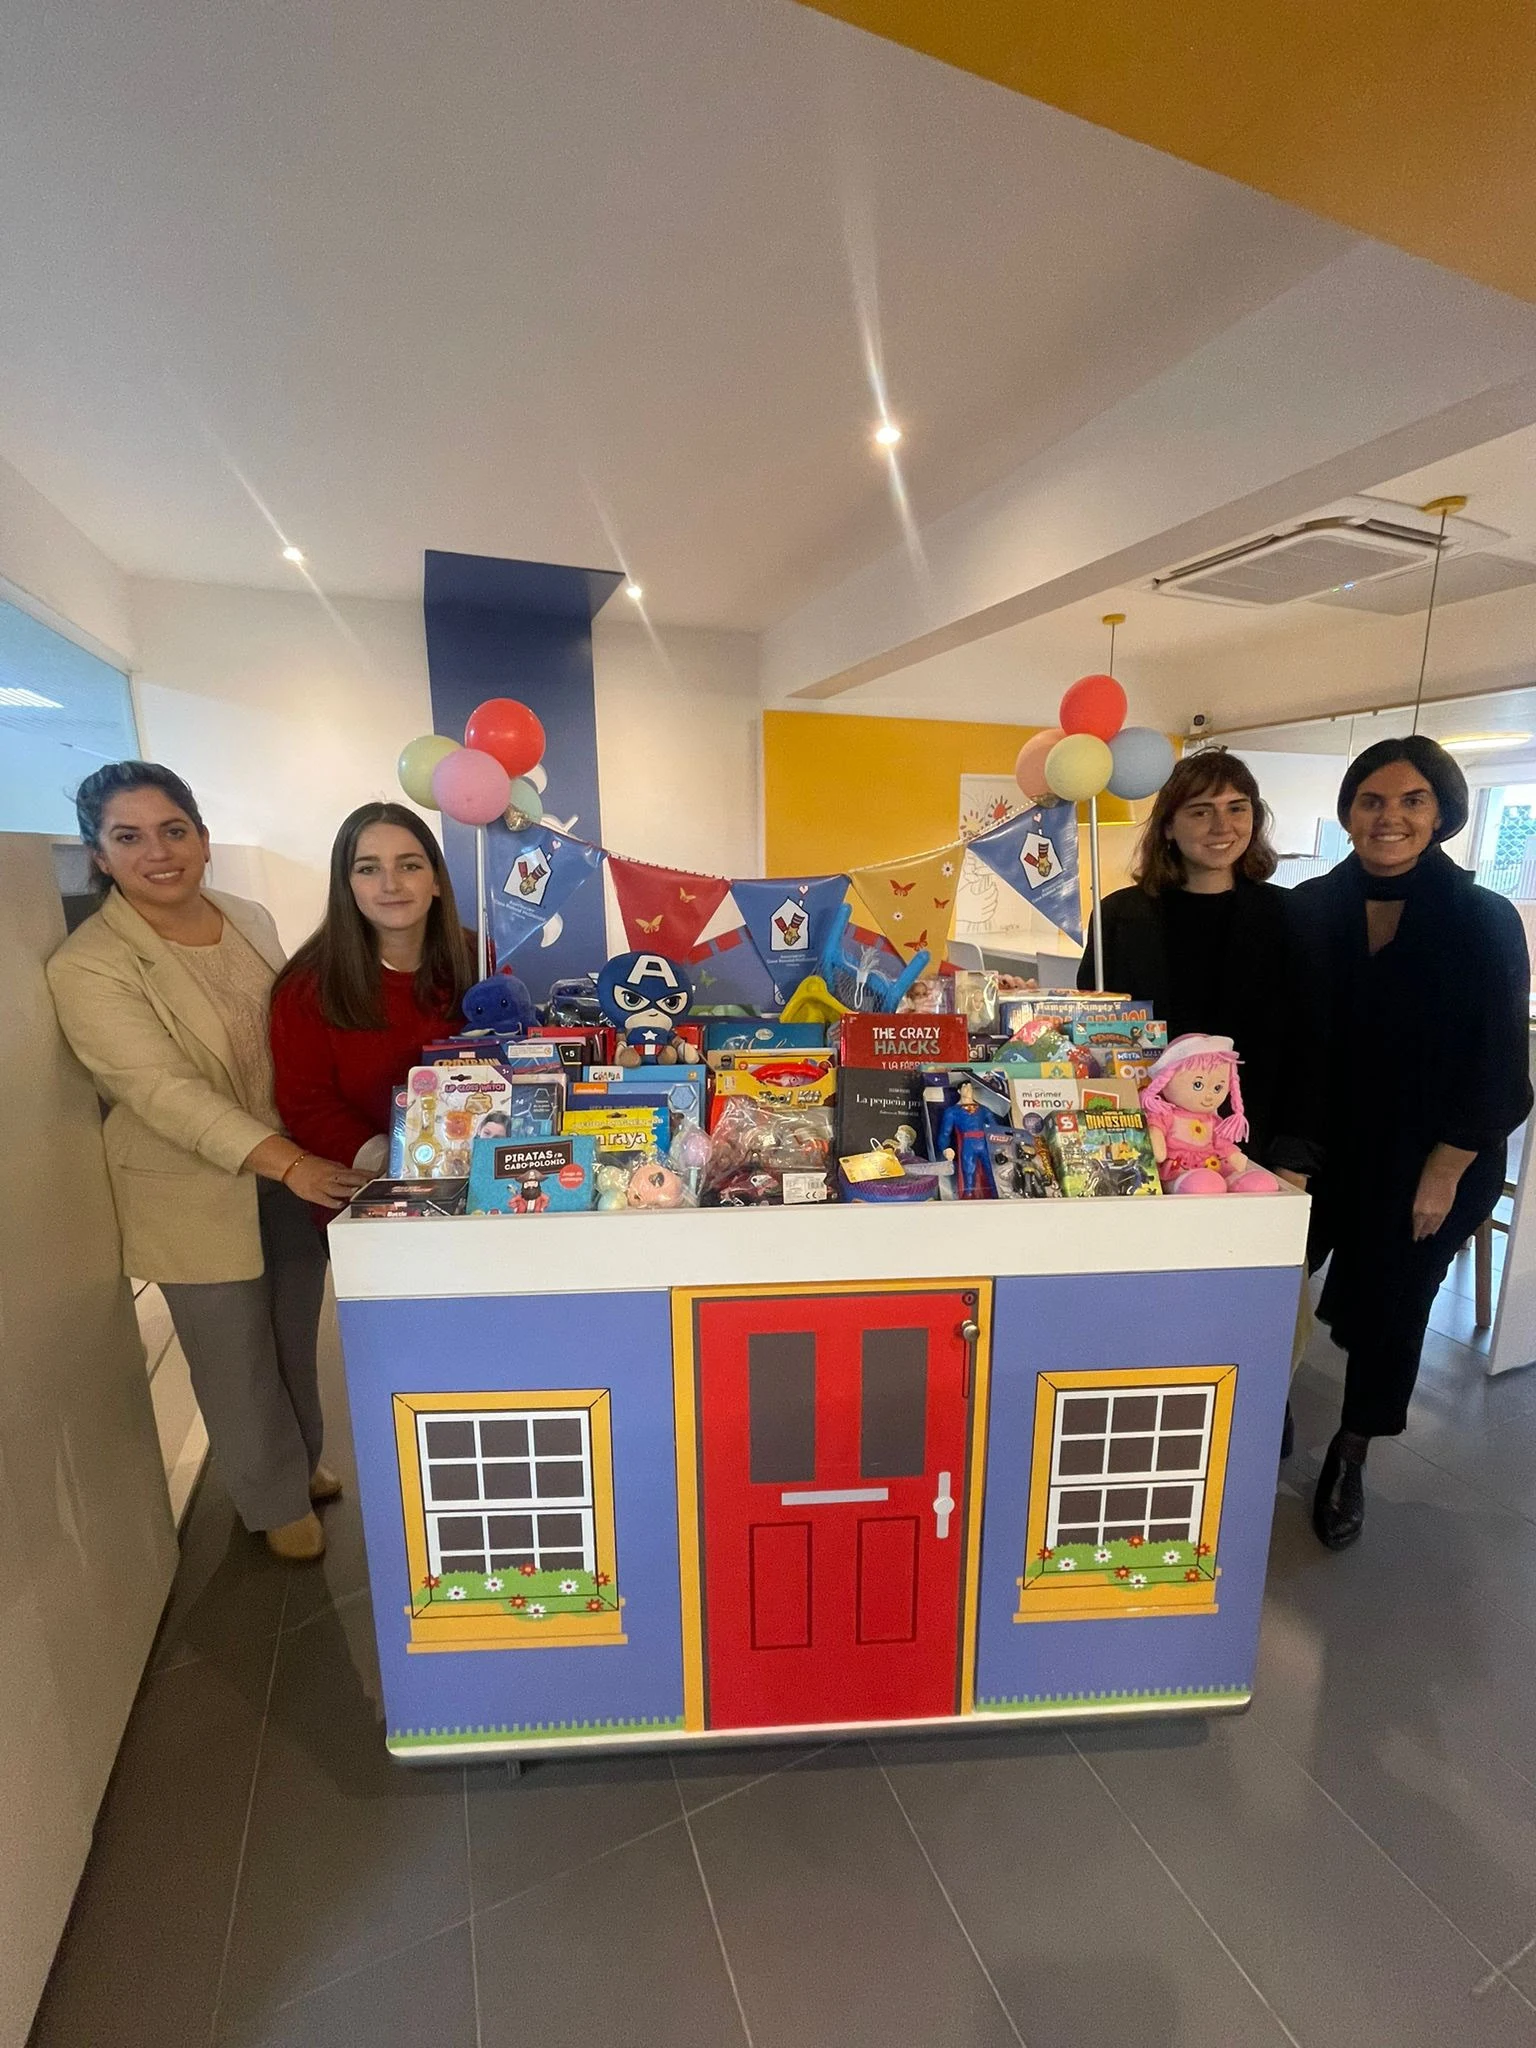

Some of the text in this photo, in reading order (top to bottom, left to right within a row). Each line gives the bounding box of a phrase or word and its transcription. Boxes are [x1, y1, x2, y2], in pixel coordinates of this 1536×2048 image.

[627, 955, 679, 988] A
[872, 1027, 941, 1040] THE CRAZY
[874, 1040, 941, 1055] HAACKS
[881, 1061, 887, 1070] Y
[888, 1061, 898, 1071] LA
[759, 1090, 793, 1105] Tool
[856, 1093, 868, 1104] La
[869, 1096, 906, 1108] pequeña
[1023, 1099, 1074, 1110] memory
[1085, 1113, 1144, 1130] DINOSAUR
[608, 1131, 648, 1149] raya
[504, 1150, 554, 1163] PIRATAS
[529, 1158, 566, 1168] POLONIO
